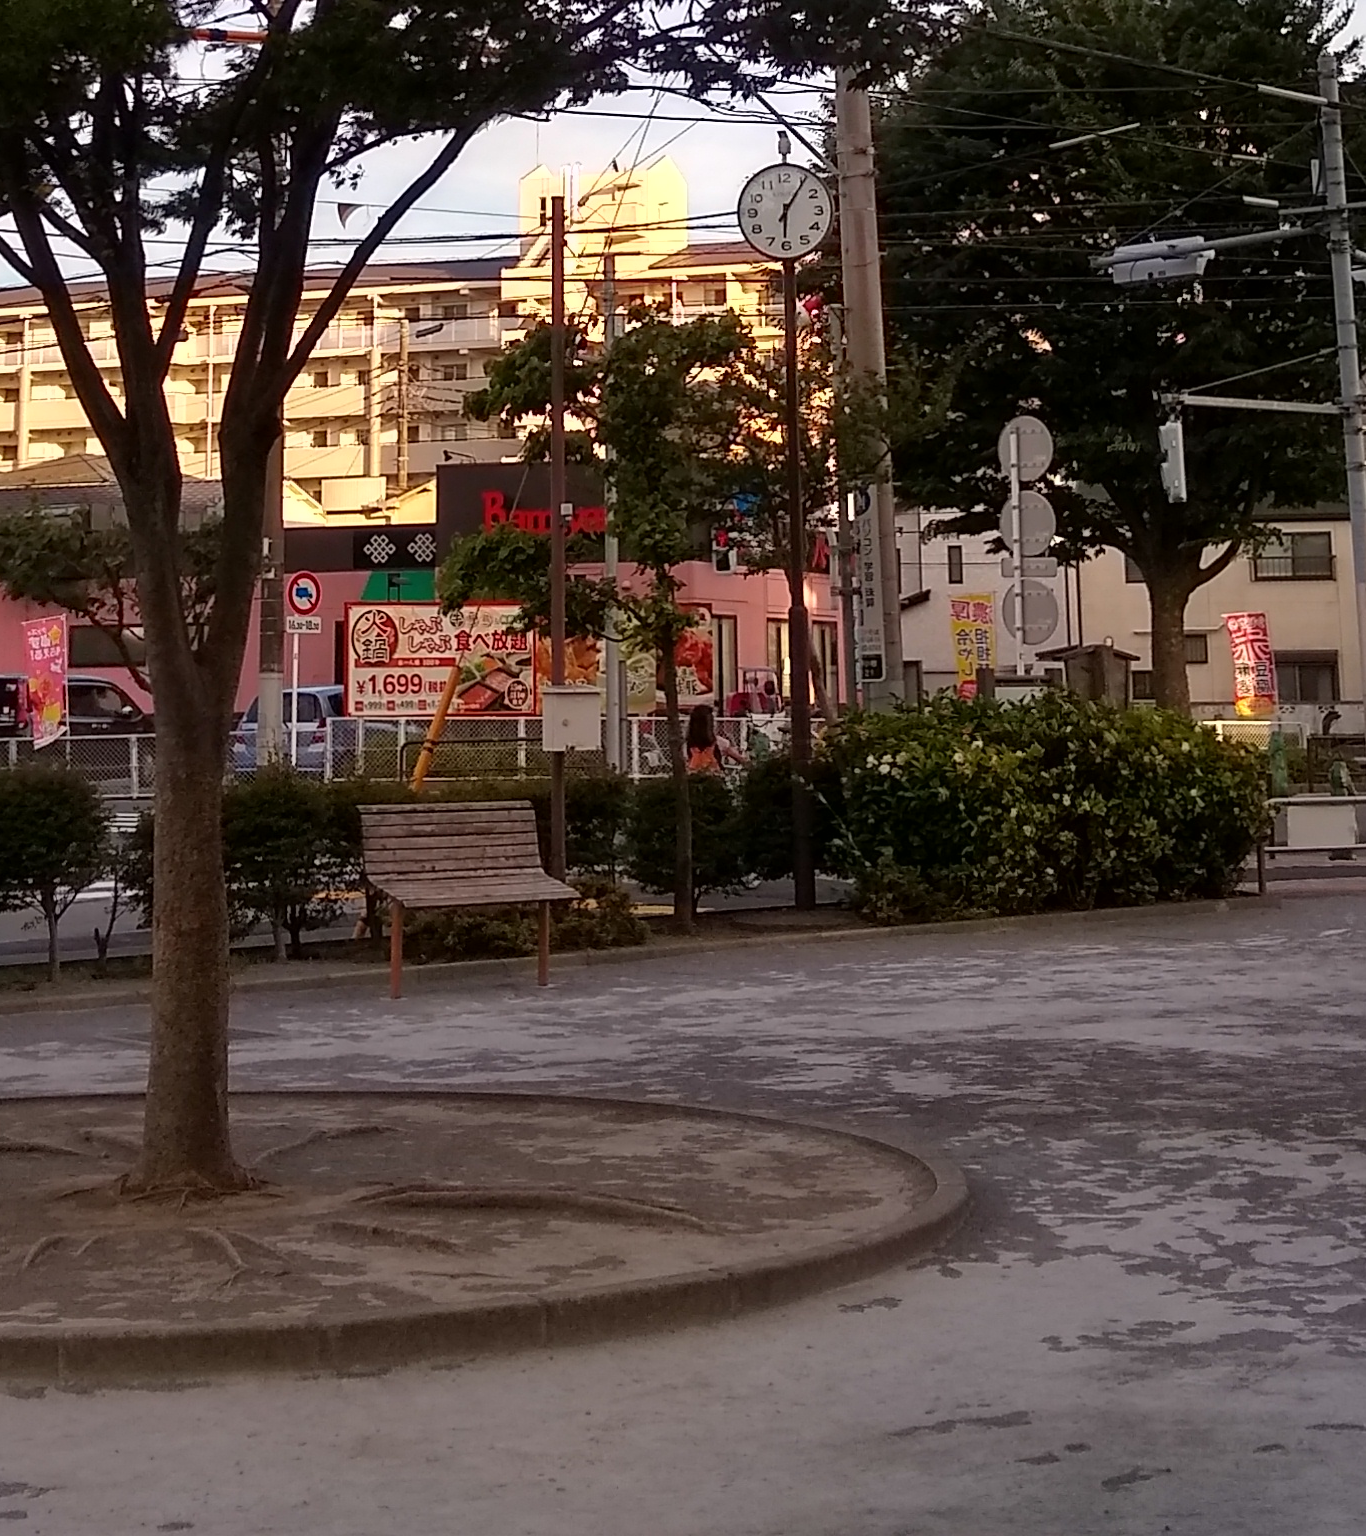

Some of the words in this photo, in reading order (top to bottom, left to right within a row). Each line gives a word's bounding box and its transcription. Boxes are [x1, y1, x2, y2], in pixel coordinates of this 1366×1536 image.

[778, 173, 791, 183] 12
[762, 180, 773, 190] 11
[750, 193, 763, 203] 10
[808, 188, 819, 199] 2
[747, 208, 758, 218] 9
[814, 205, 824, 216] 3
[751, 223, 763, 234] 8
[808, 221, 821, 231] 4
[765, 236, 776, 247] 7
[799, 234, 811, 245] 5
[781, 240, 792, 251] 6
[398, 616, 444, 635] しゃぶ
[407, 634, 453, 653] しゃぶ
[453, 629, 528, 653] 食べ放題
